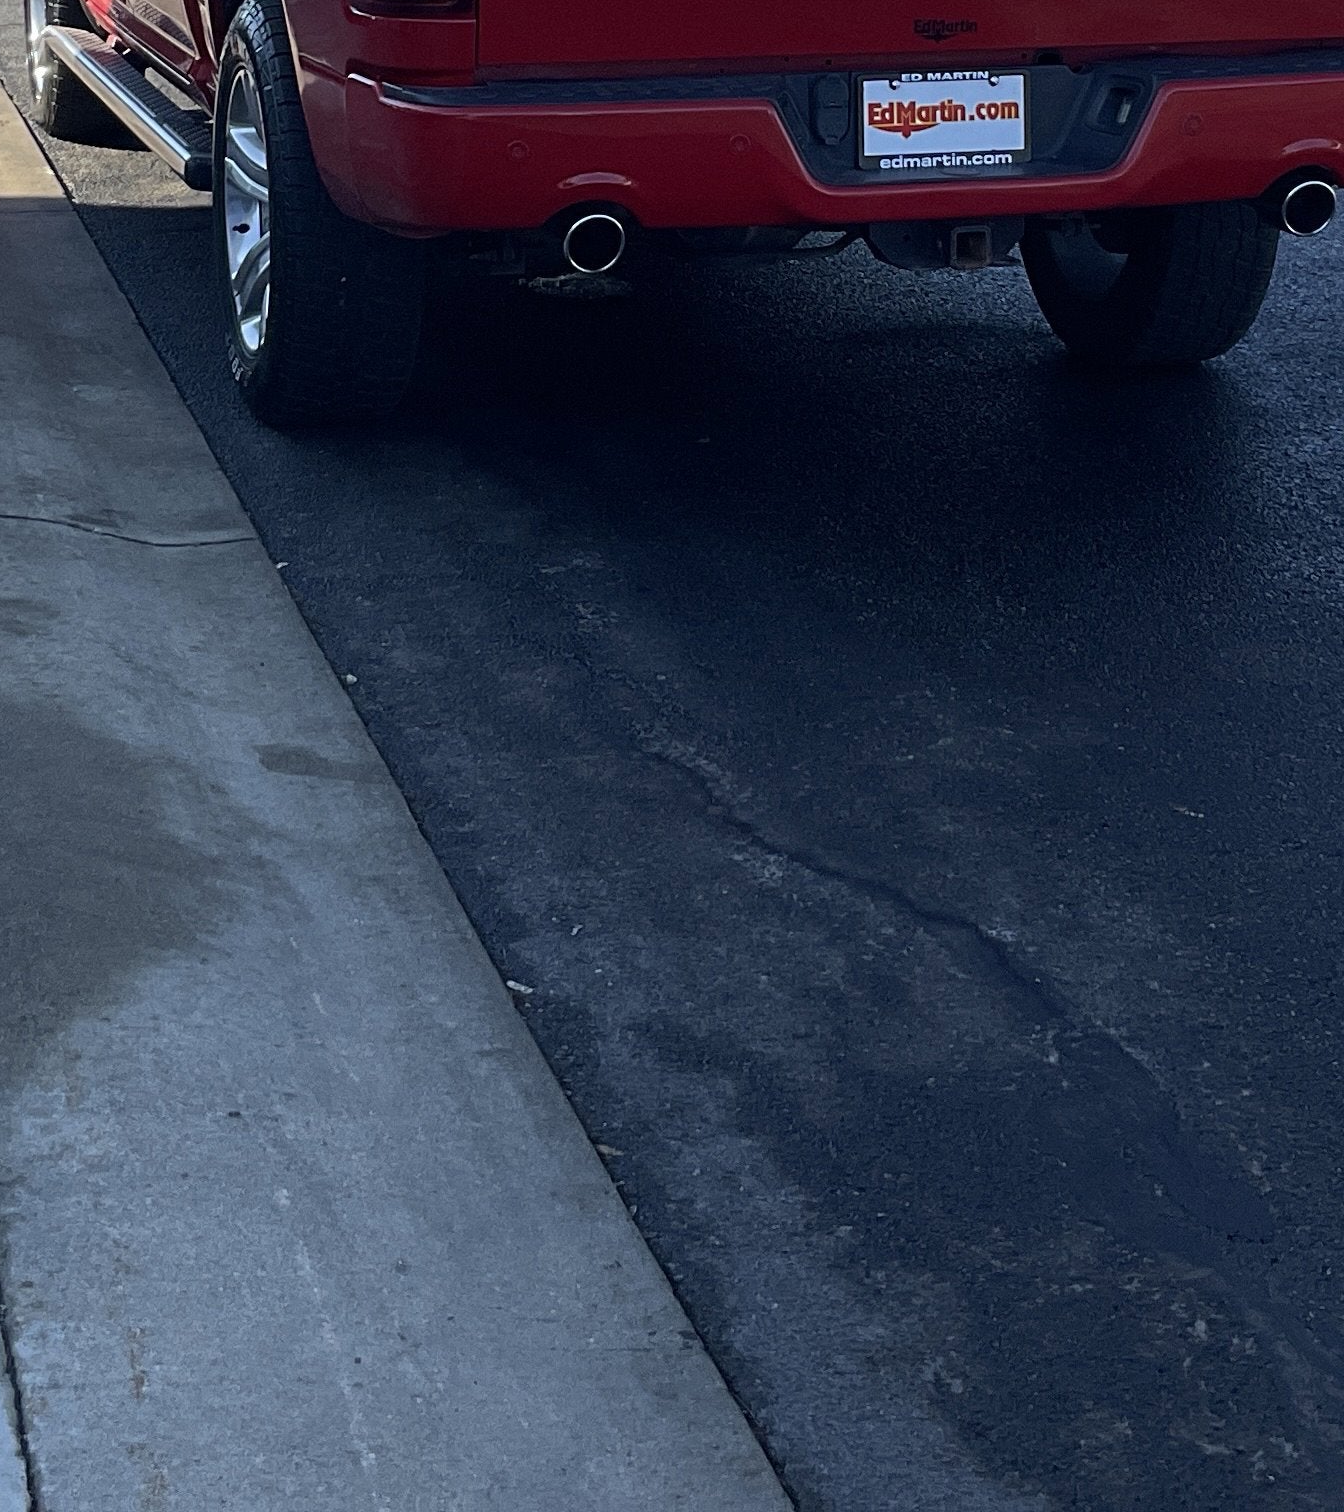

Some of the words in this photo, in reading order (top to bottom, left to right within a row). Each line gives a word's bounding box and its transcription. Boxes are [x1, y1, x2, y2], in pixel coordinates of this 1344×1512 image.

[901, 73, 923, 82] ED
[927, 70, 989, 81] MARTIN
[879, 152, 1013, 169] edmartin.com
